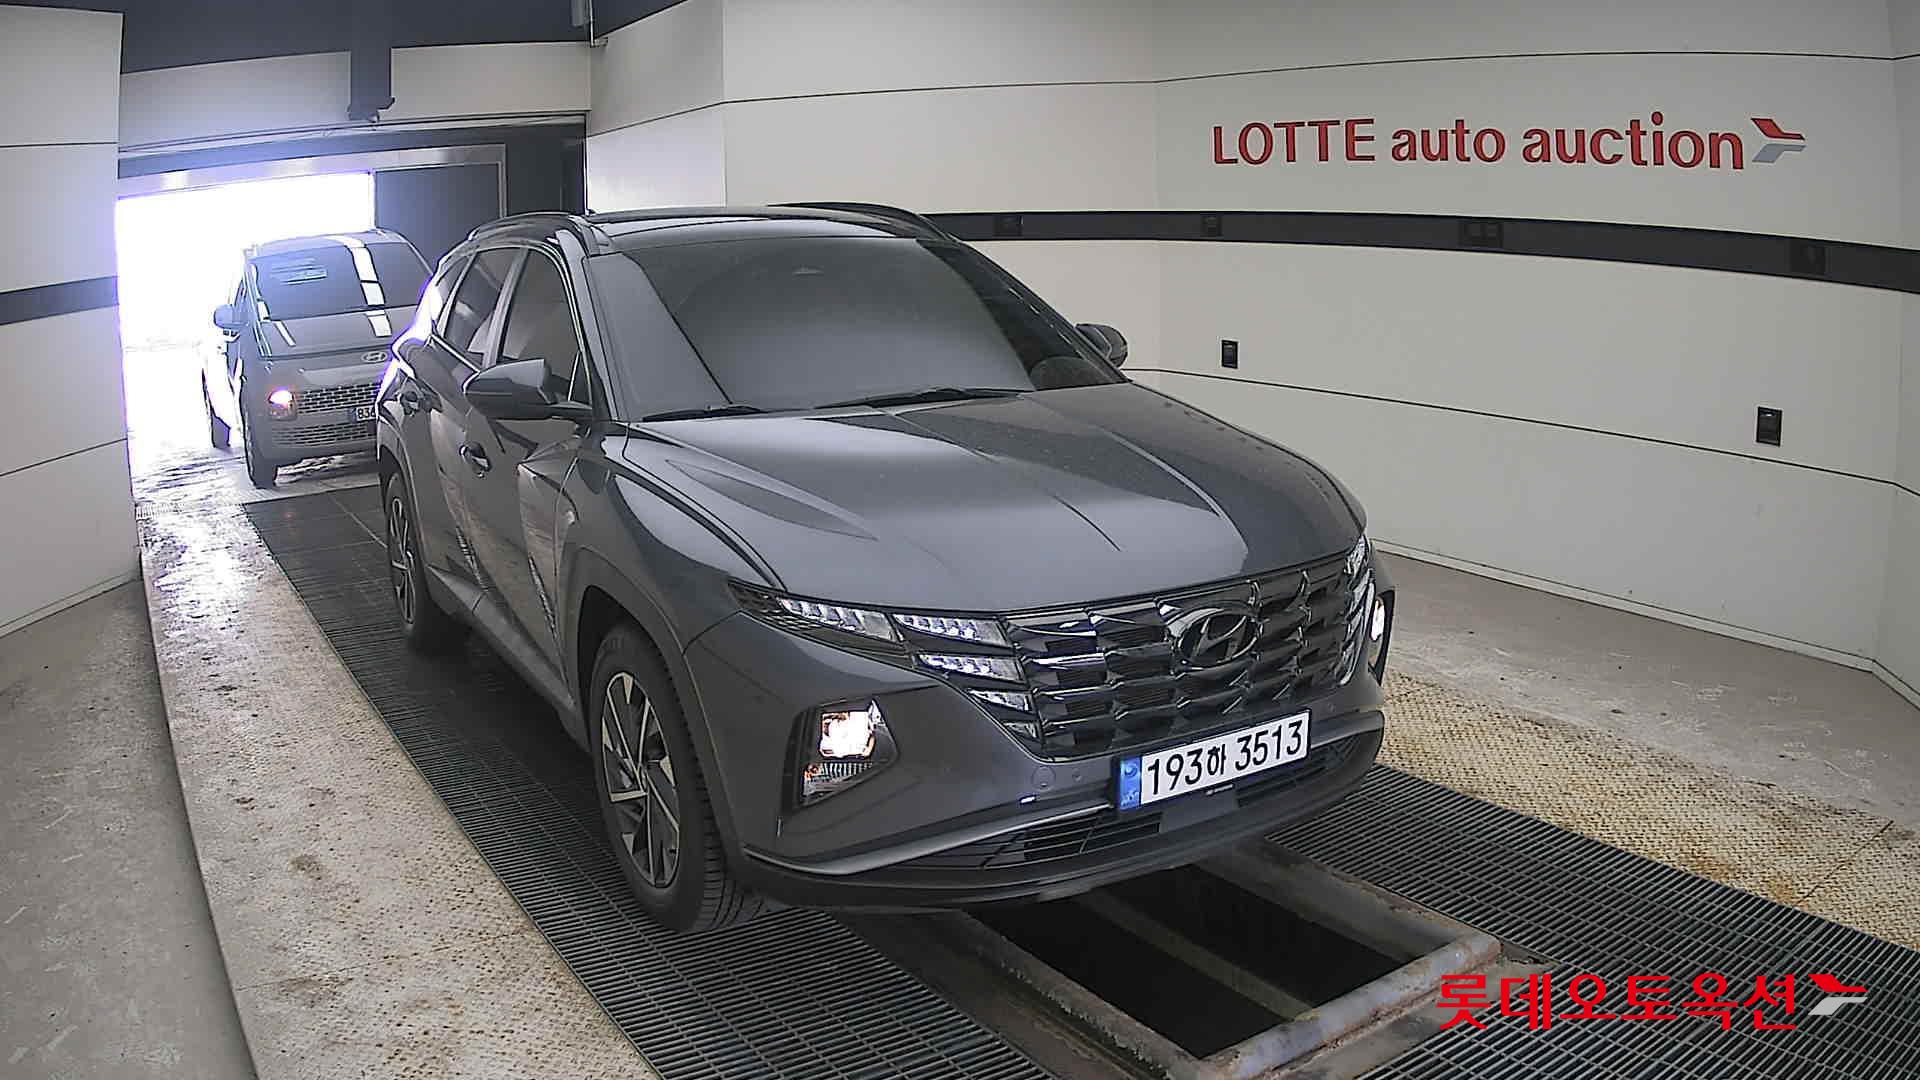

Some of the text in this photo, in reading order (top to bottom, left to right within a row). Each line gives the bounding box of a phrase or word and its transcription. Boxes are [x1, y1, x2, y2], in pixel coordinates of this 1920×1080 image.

[1214, 111, 1745, 170] LOTTE auto auction
[1147, 719, 1304, 795] 193하 3513
